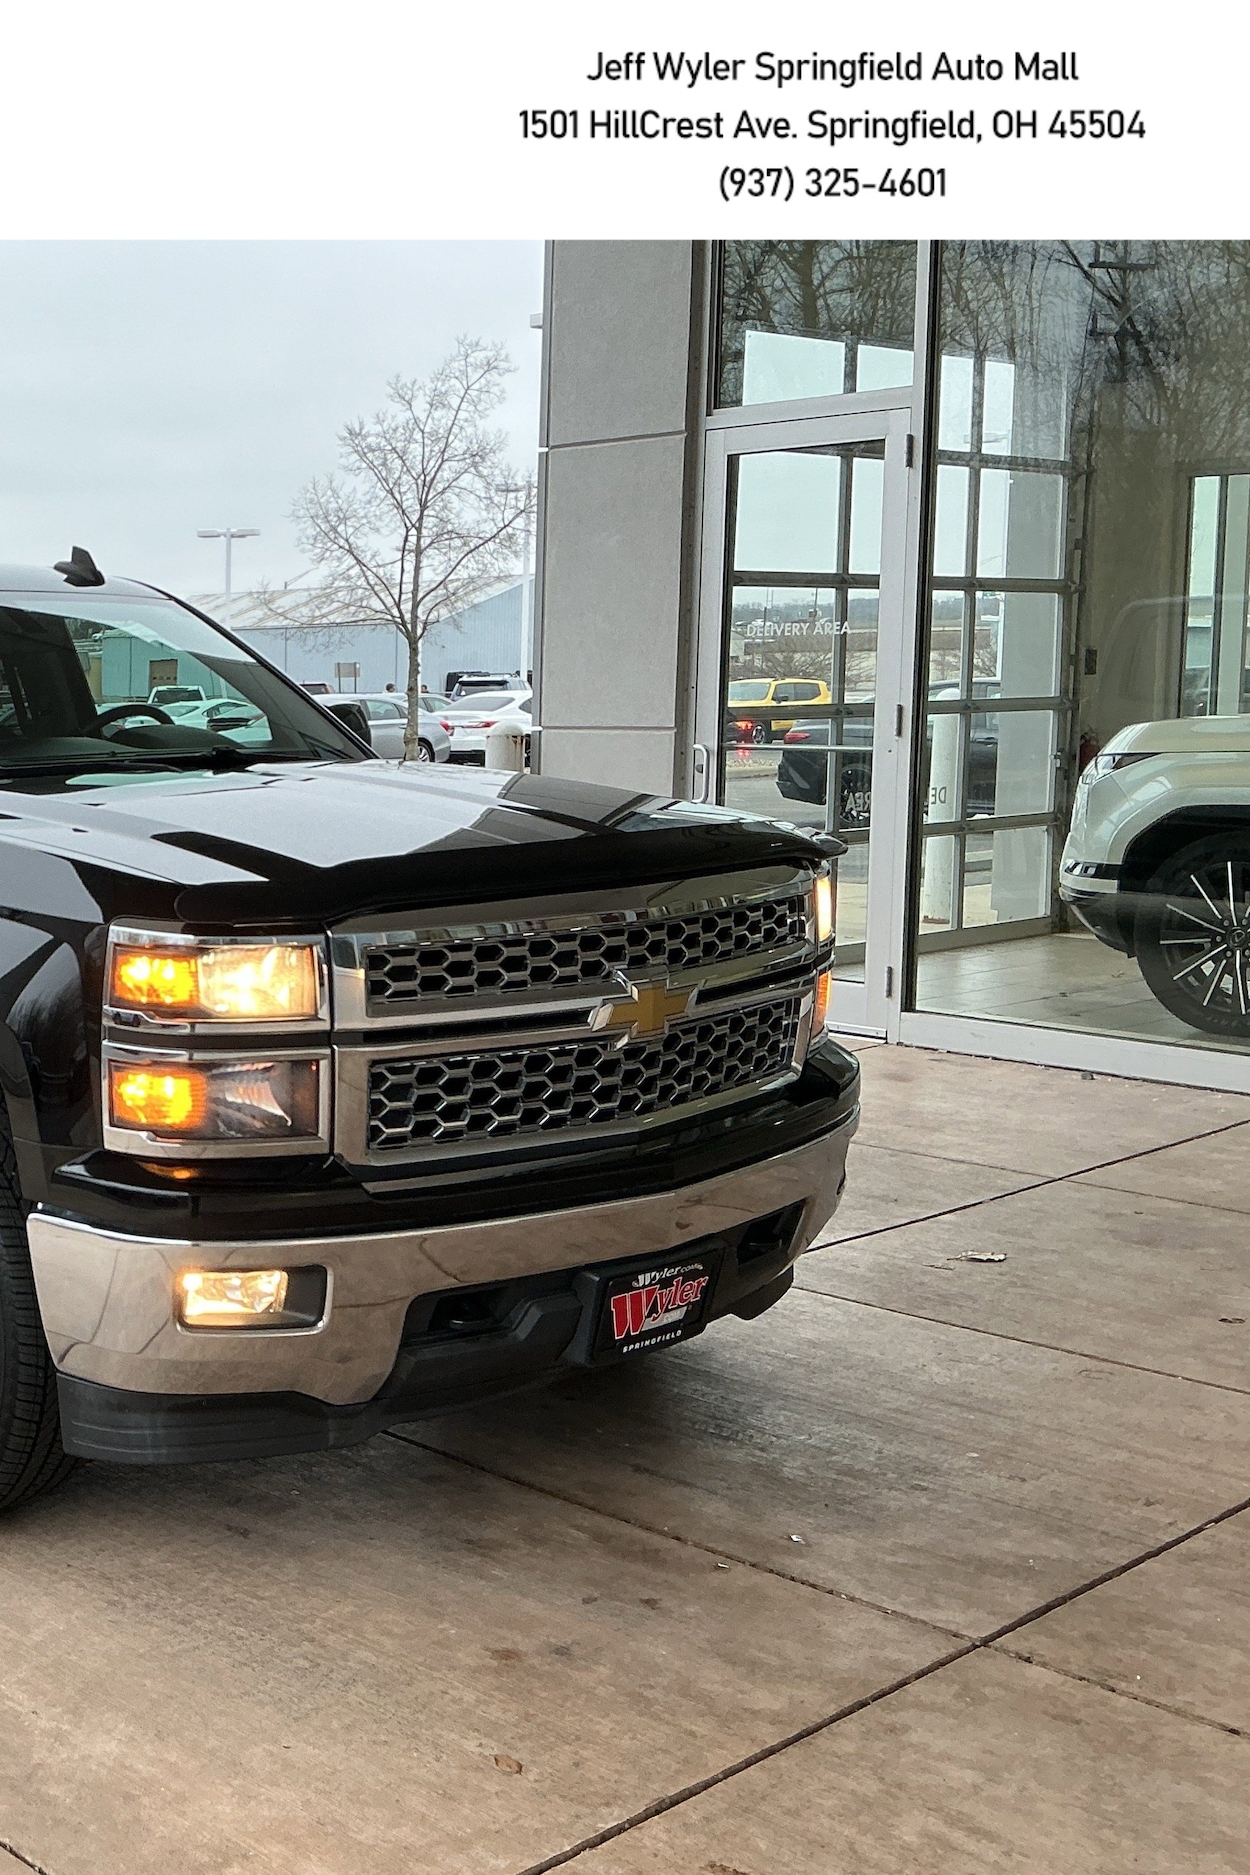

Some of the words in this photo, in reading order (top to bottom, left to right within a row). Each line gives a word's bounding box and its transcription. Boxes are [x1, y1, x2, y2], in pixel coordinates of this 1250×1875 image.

[746, 622, 810, 637] DELIVERY
[813, 620, 851, 636] AREA
[611, 1276, 709, 1339] Wyler
[622, 1329, 682, 1353] SPRINGFIELD
